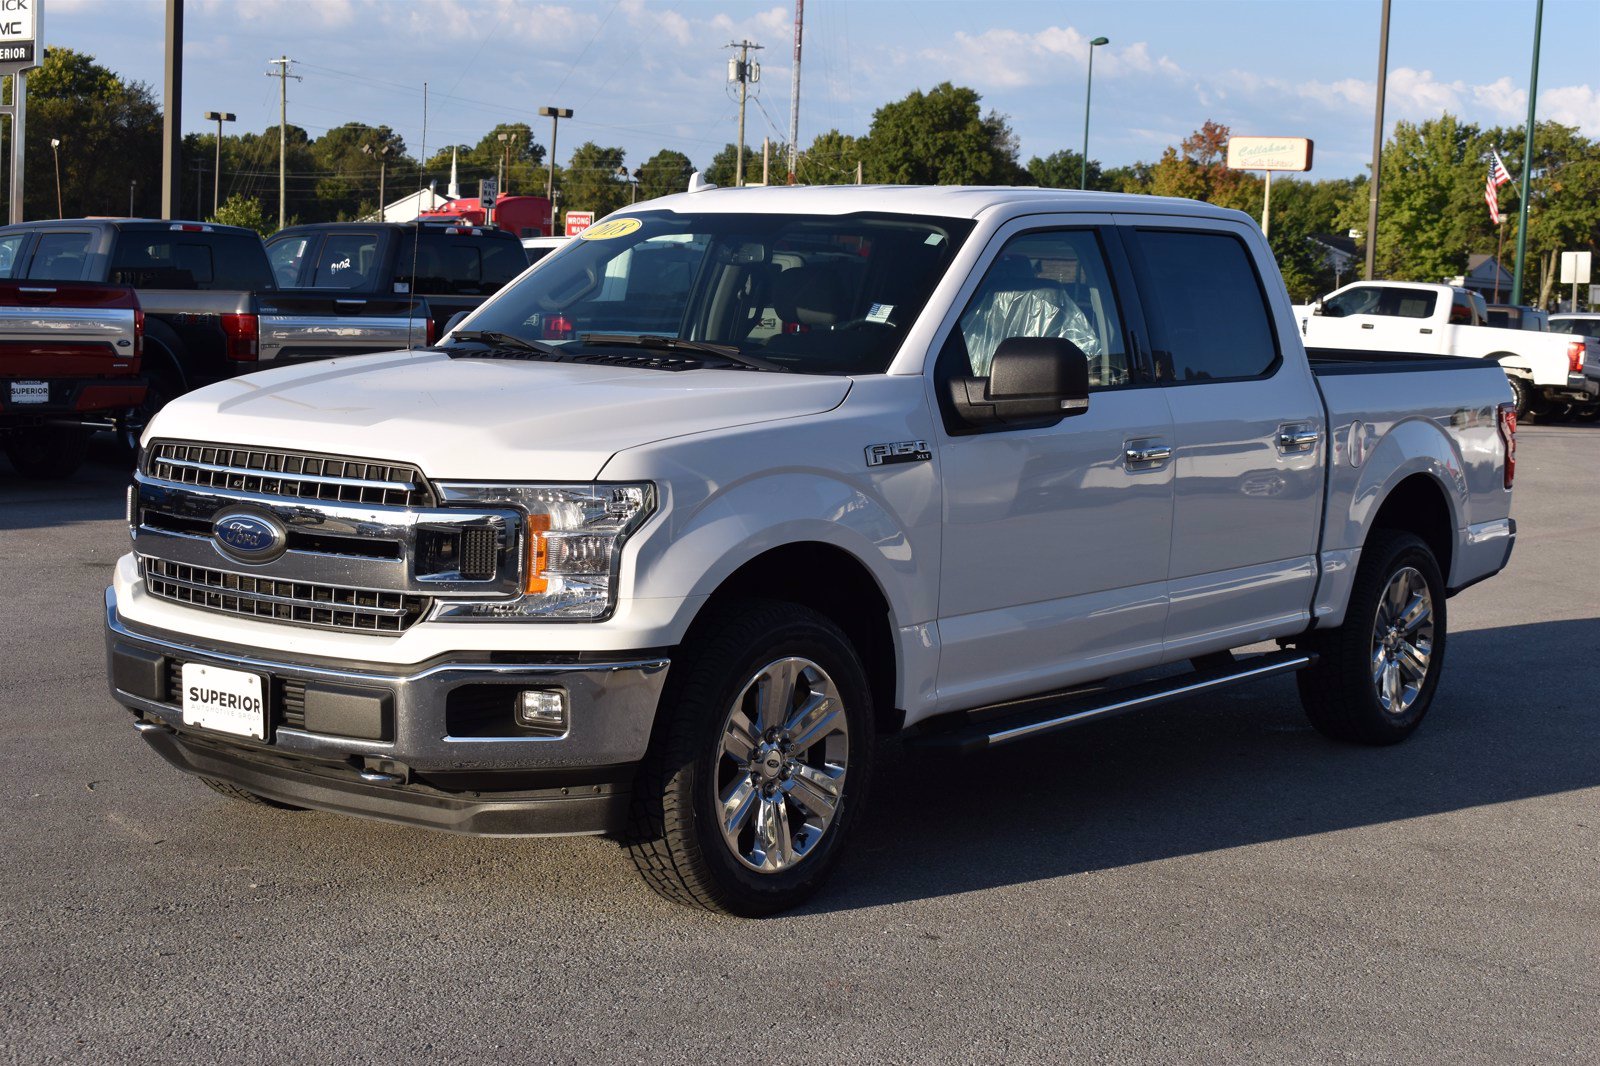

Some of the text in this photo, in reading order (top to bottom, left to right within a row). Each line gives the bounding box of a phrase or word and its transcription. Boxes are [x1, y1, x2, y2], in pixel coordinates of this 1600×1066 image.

[483, 181, 496, 190] ONE
[567, 217, 590, 225] WRONG
[11, 387, 49, 395] SUPERIOR
[226, 521, 263, 546] Ford
[189, 686, 261, 715] SUPERIOR
